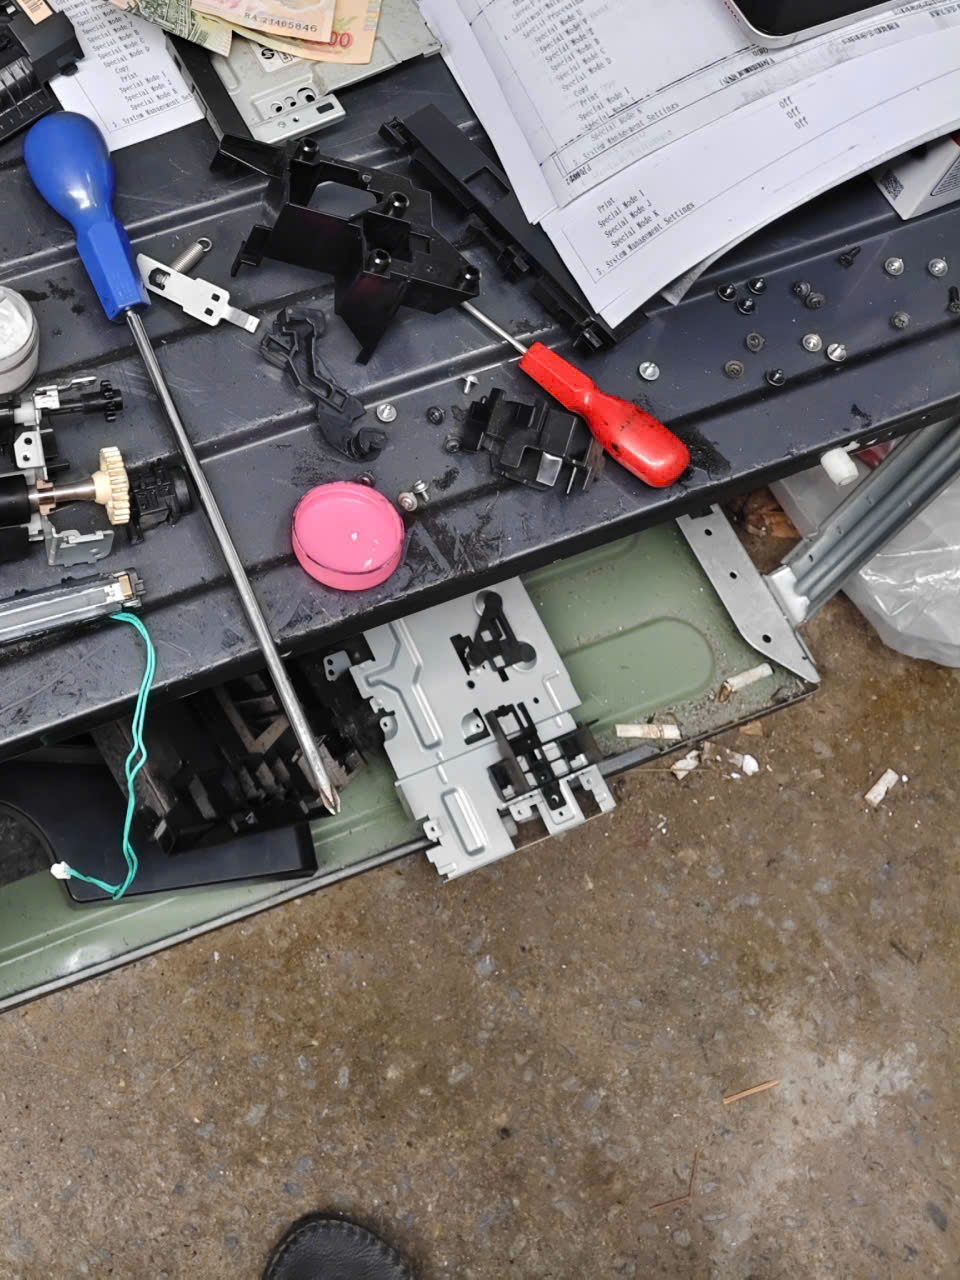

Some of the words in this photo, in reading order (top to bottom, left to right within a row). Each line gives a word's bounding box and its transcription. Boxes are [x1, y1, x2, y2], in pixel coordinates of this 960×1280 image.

[76, 13, 100, 28] Special
[102, 6, 116, 16] Mode
[82, 21, 106, 36] Special
[107, 14, 122, 24] Mode
[533, 22, 558, 43] Special
[559, 12, 575, 26] Mode
[87, 29, 111, 44] Special
[112, 22, 127, 32] Mode
[92, 37, 116, 52] Special
[118, 31, 132, 41] Mode
[538, 33, 564, 53] Special
[564, 21, 581, 35] Mode
[97, 46, 122, 60] Special
[123, 39, 138, 49] Mode
[103, 54, 127, 68] Special
[129, 48, 143, 57] Mode
[544, 42, 570, 63] Special
[570, 31, 586, 45] Mode
[549, 52, 575, 72] Special
[576, 41, 592, 54] Mode
[120, 71, 137, 82] Print
[555, 62, 581, 82] Special
[582, 50, 598, 64] Mode
[560, 72, 587, 92] Special
[588, 60, 604, 74] Mode
[119, 79, 144, 93] Special
[145, 73, 159, 83] Mode
[124, 87, 149, 102] Special
[150, 81, 165, 91] Mode
[130, 96, 154, 110] Special
[156, 90, 171, 99] Mode
[577, 101, 604, 121] Special
[606, 91, 622, 104] Mode
[778, 96, 792, 109] Off
[785, 106, 800, 119] Off
[793, 116, 808, 129] Off
[596, 196, 615, 213] Print
[597, 205, 623, 229] Special
[622, 194, 638, 208] Mode
[603, 216, 630, 239] Special
[629, 203, 645, 219] Mode
[610, 226, 636, 249] Special
[635, 214, 652, 229] Mode
[604, 248, 628, 270] System
[627, 222, 663, 253] Management
[663, 200, 696, 227] Settings
